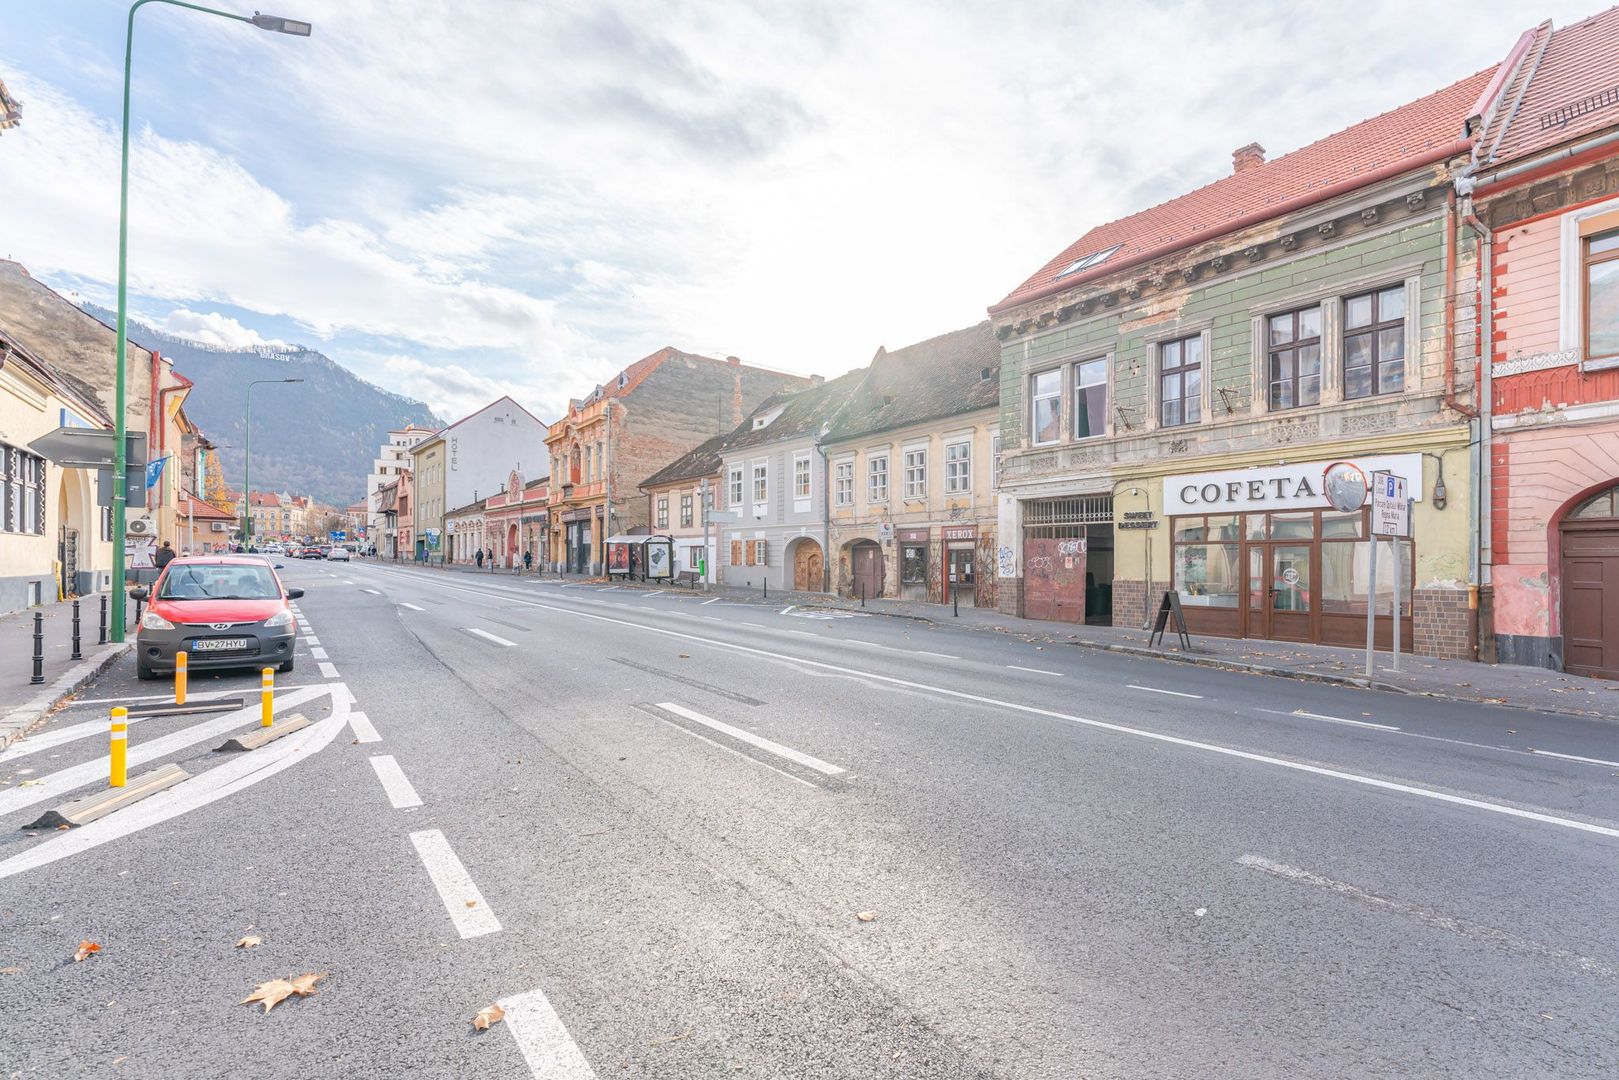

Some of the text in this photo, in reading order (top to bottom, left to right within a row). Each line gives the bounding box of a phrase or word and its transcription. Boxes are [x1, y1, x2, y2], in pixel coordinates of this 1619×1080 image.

[1123, 511, 1153, 520] SWEET
[1118, 520, 1159, 529] DESSERT
[947, 529, 974, 539] XEROX
[197, 640, 246, 649] BV 27HYU
